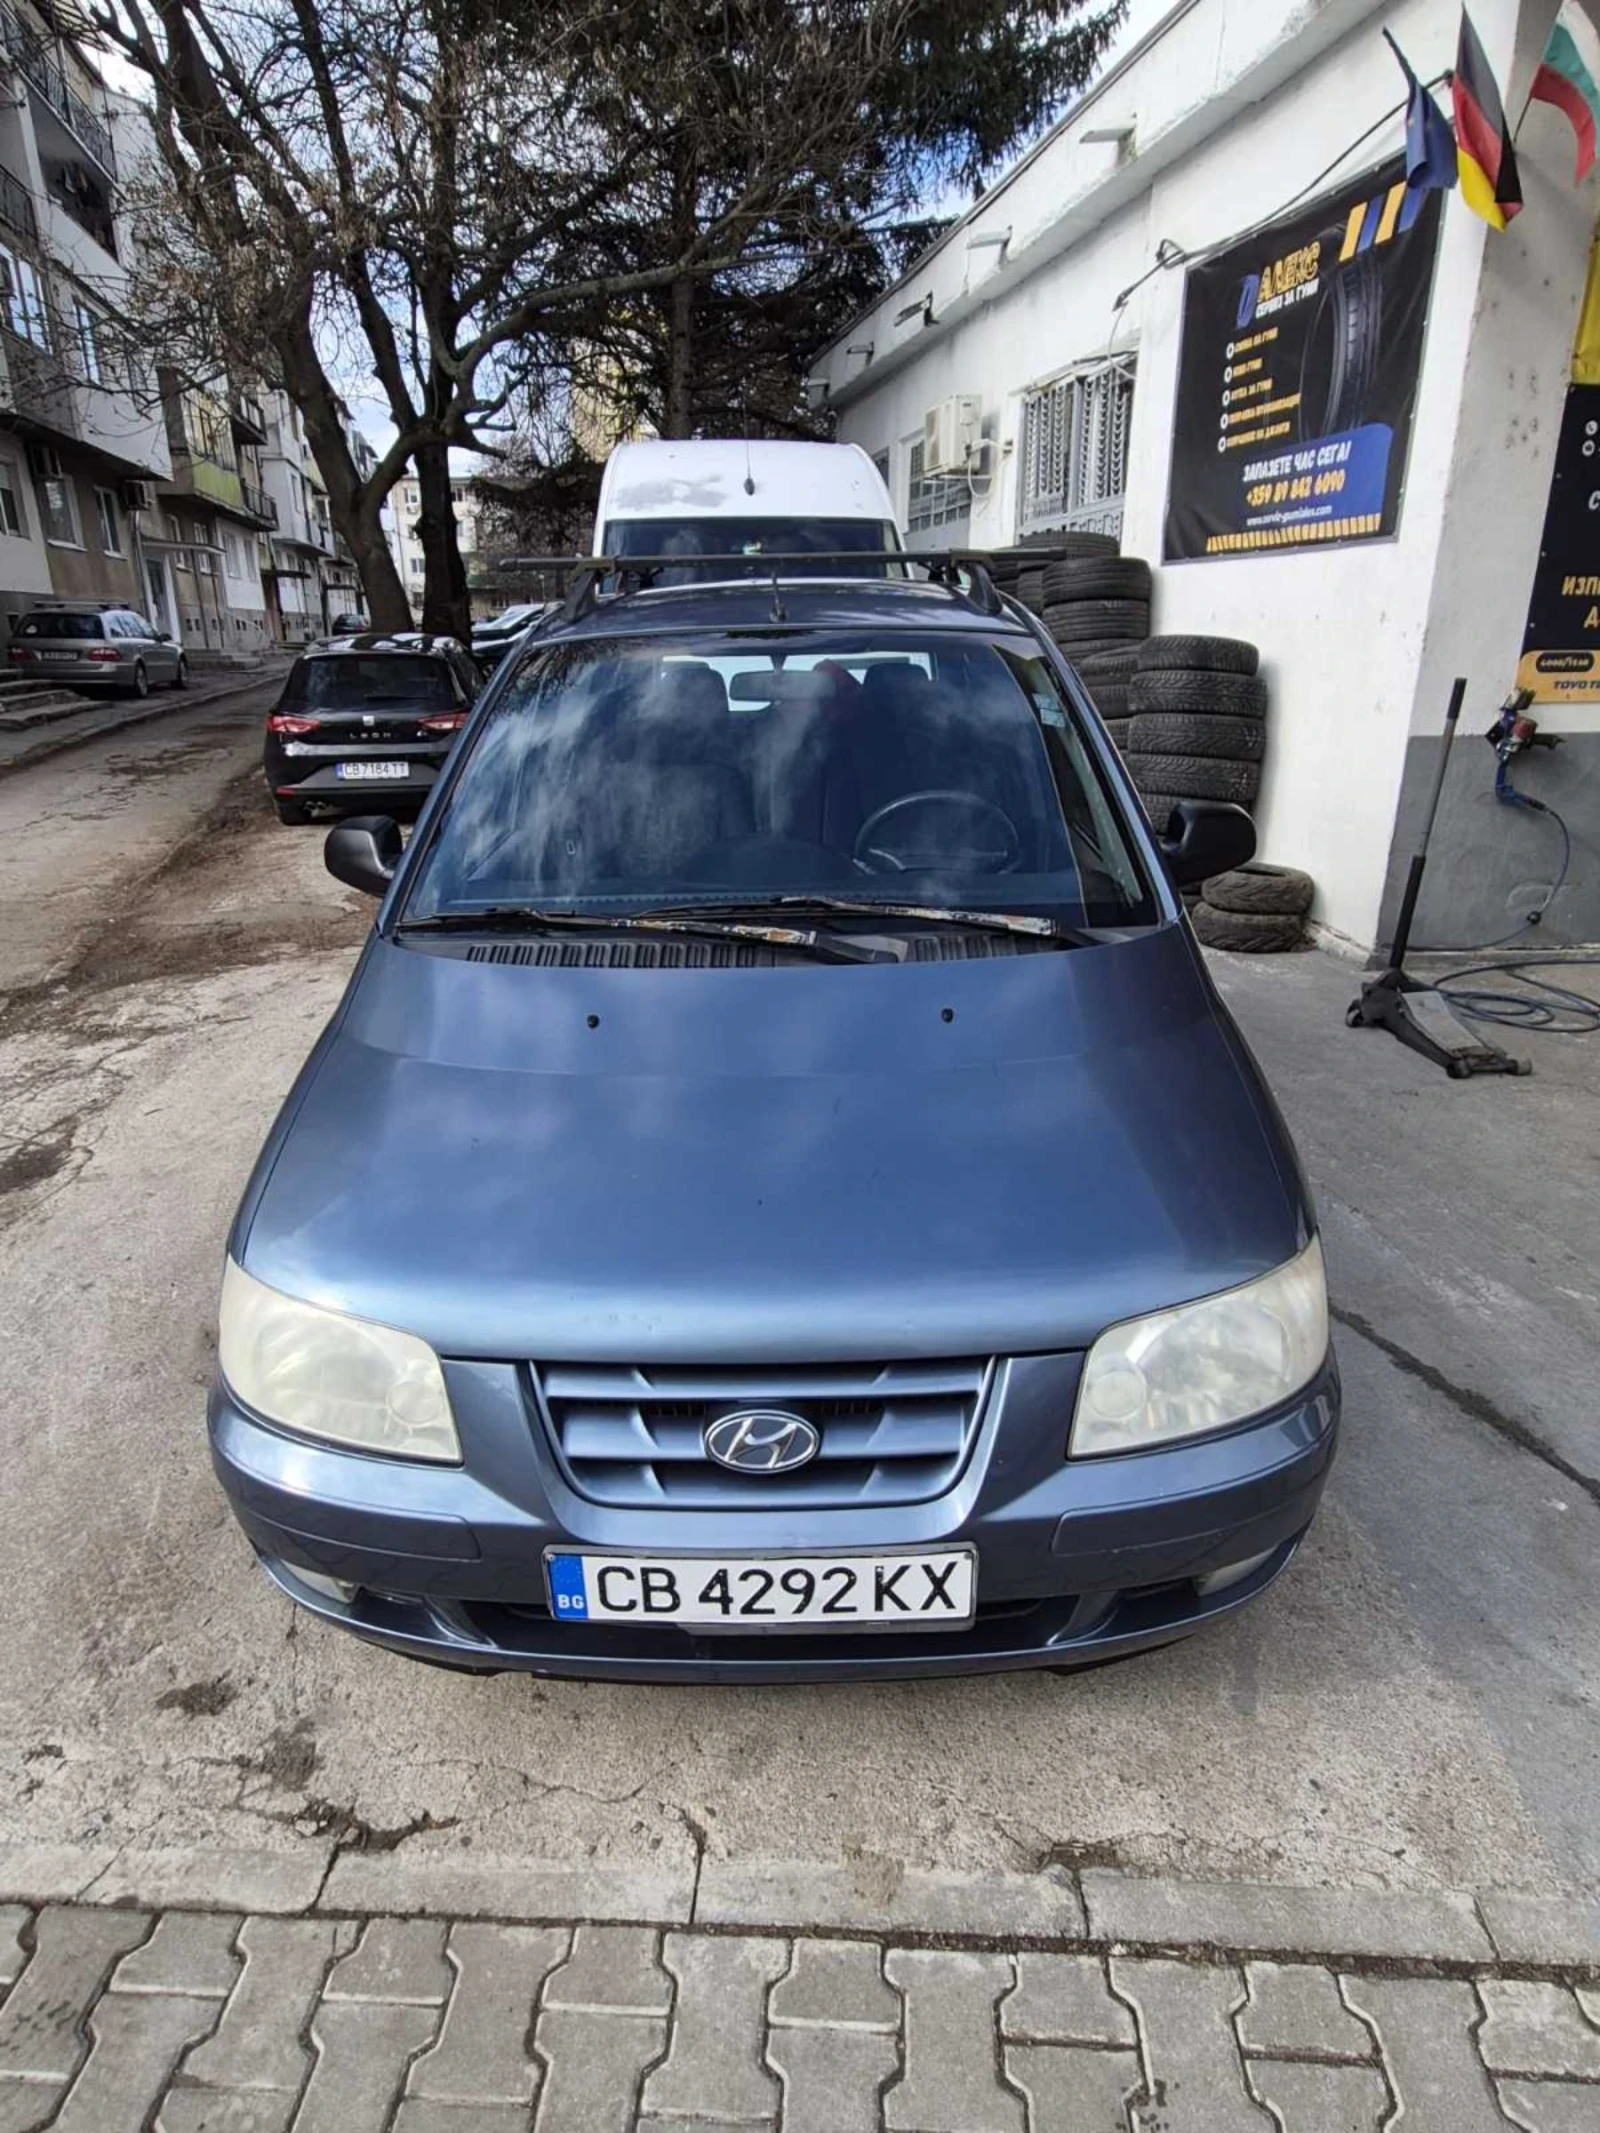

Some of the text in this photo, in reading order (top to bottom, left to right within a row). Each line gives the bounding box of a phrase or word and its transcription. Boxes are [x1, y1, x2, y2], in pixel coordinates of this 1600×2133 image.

[1243, 440, 1352, 482] ЗАПАЗЕТЕ ЧАС СЕГА!
[557, 1594, 585, 1610] BG
[596, 1561, 959, 1616] CB 4292 KX
